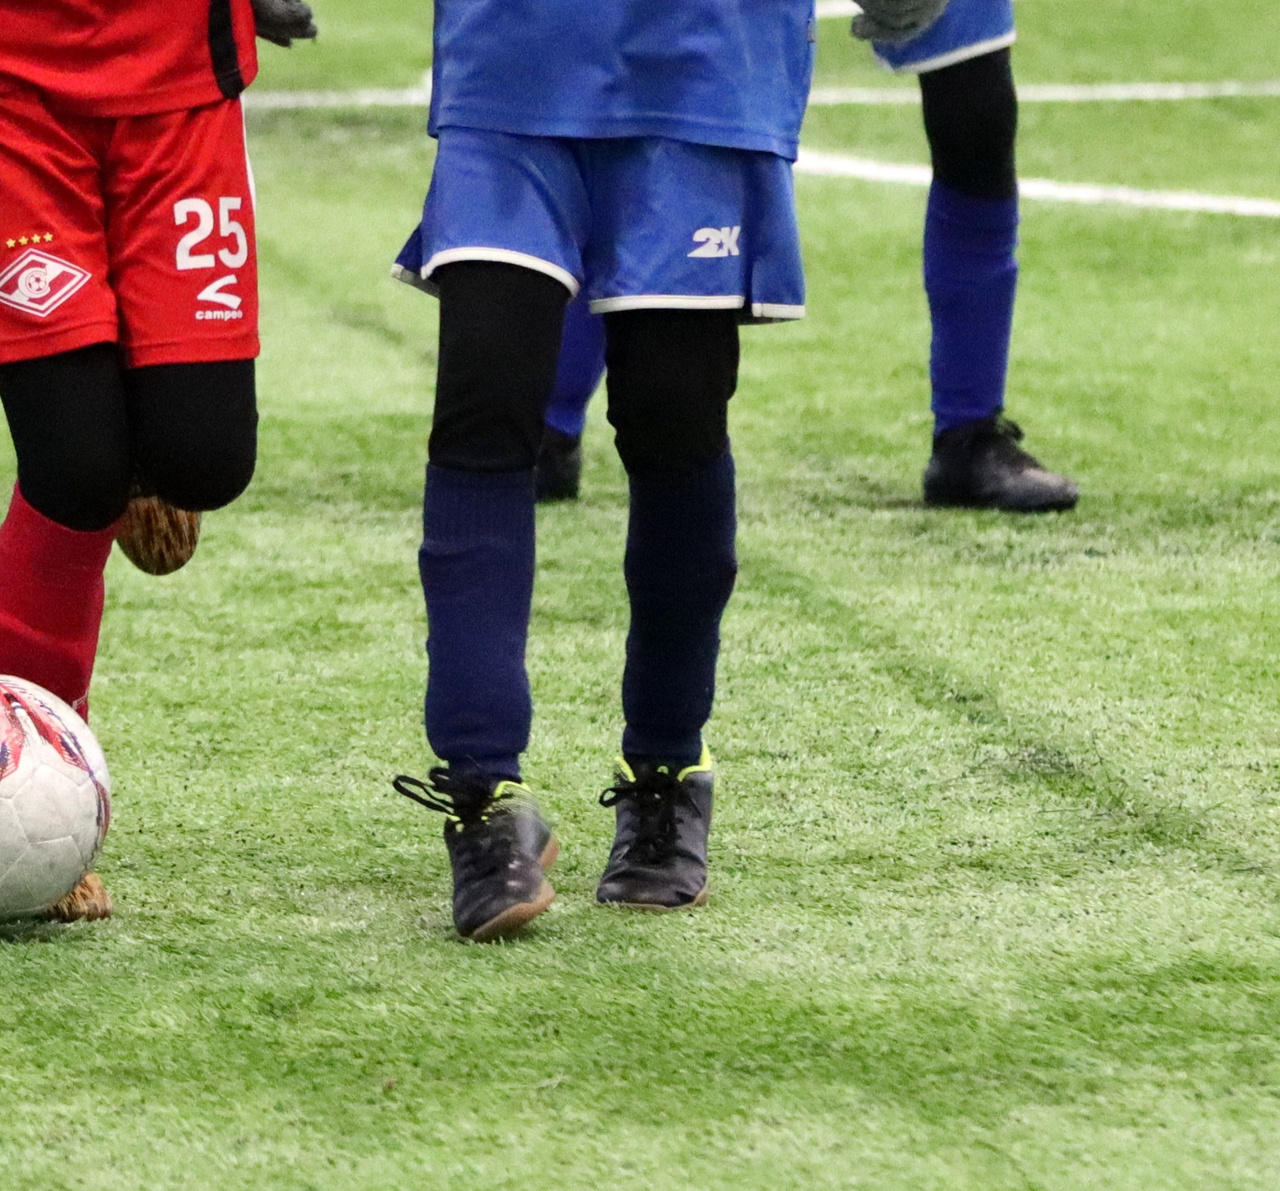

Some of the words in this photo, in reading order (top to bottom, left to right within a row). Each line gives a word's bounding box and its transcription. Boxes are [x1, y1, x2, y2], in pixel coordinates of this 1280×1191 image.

[173, 196, 248, 270] 25
[687, 225, 741, 258] 2K
[195, 309, 244, 321] campeo
